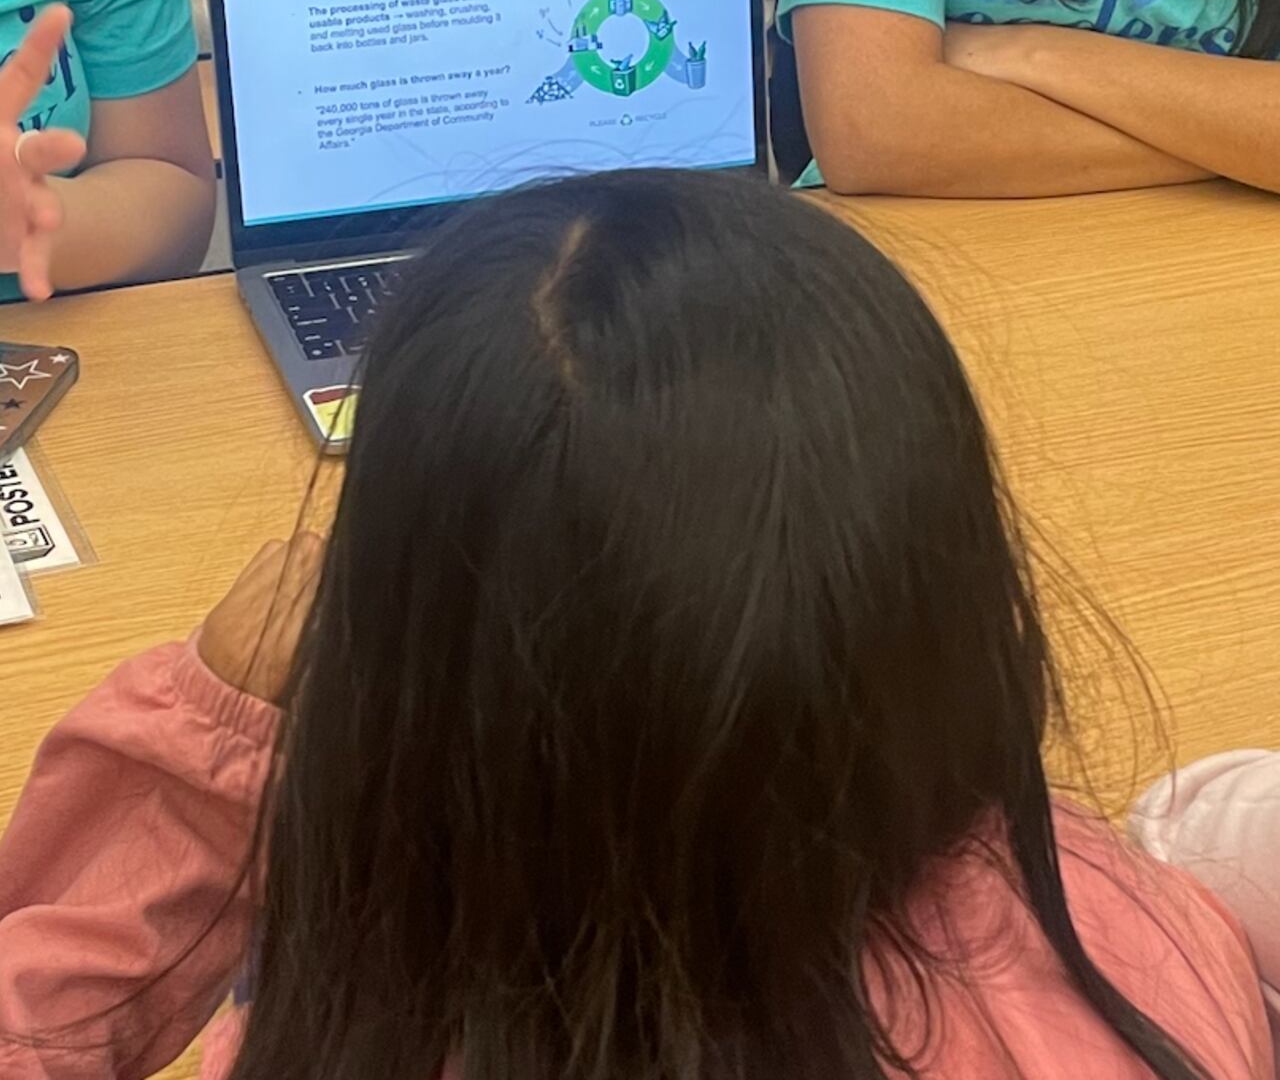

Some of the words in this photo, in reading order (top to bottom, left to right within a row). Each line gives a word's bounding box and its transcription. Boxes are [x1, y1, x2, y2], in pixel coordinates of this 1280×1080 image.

[308, 7, 328, 16] The
[330, 1, 386, 15] processing
[389, 0, 399, 9] of
[309, 17, 343, 29] usable
[346, 13, 390, 26] products
[310, 31, 328, 40] and
[331, 26, 364, 39] melting
[367, 25, 390, 35] used
[393, 21, 417, 33] glass
[420, 18, 449, 30] before
[311, 43, 333, 52] back
[336, 40, 353, 49] into
[356, 37, 387, 48] bottles
[389, 35, 407, 44] and
[314, 84, 337, 94] How
[339, 81, 367, 91] much
[370, 78, 396, 90] glass
[410, 73, 445, 84] thrown
[448, 70, 472, 81] away
[484, 65, 511, 78] year?
[360, 100, 380, 110] tons
[394, 96, 418, 108] glass
[431, 91, 461, 102] thrown
[464, 89, 488, 100] away
[317, 117, 342, 128] every
[345, 112, 373, 124] single
[375, 111, 395, 122] year
[409, 107, 424, 117] the
[454, 99, 497, 112] according
[318, 128, 333, 138] the
[335, 124, 372, 137] Georgia
[375, 118, 429, 132] Department
[443, 111, 494, 125] Community
